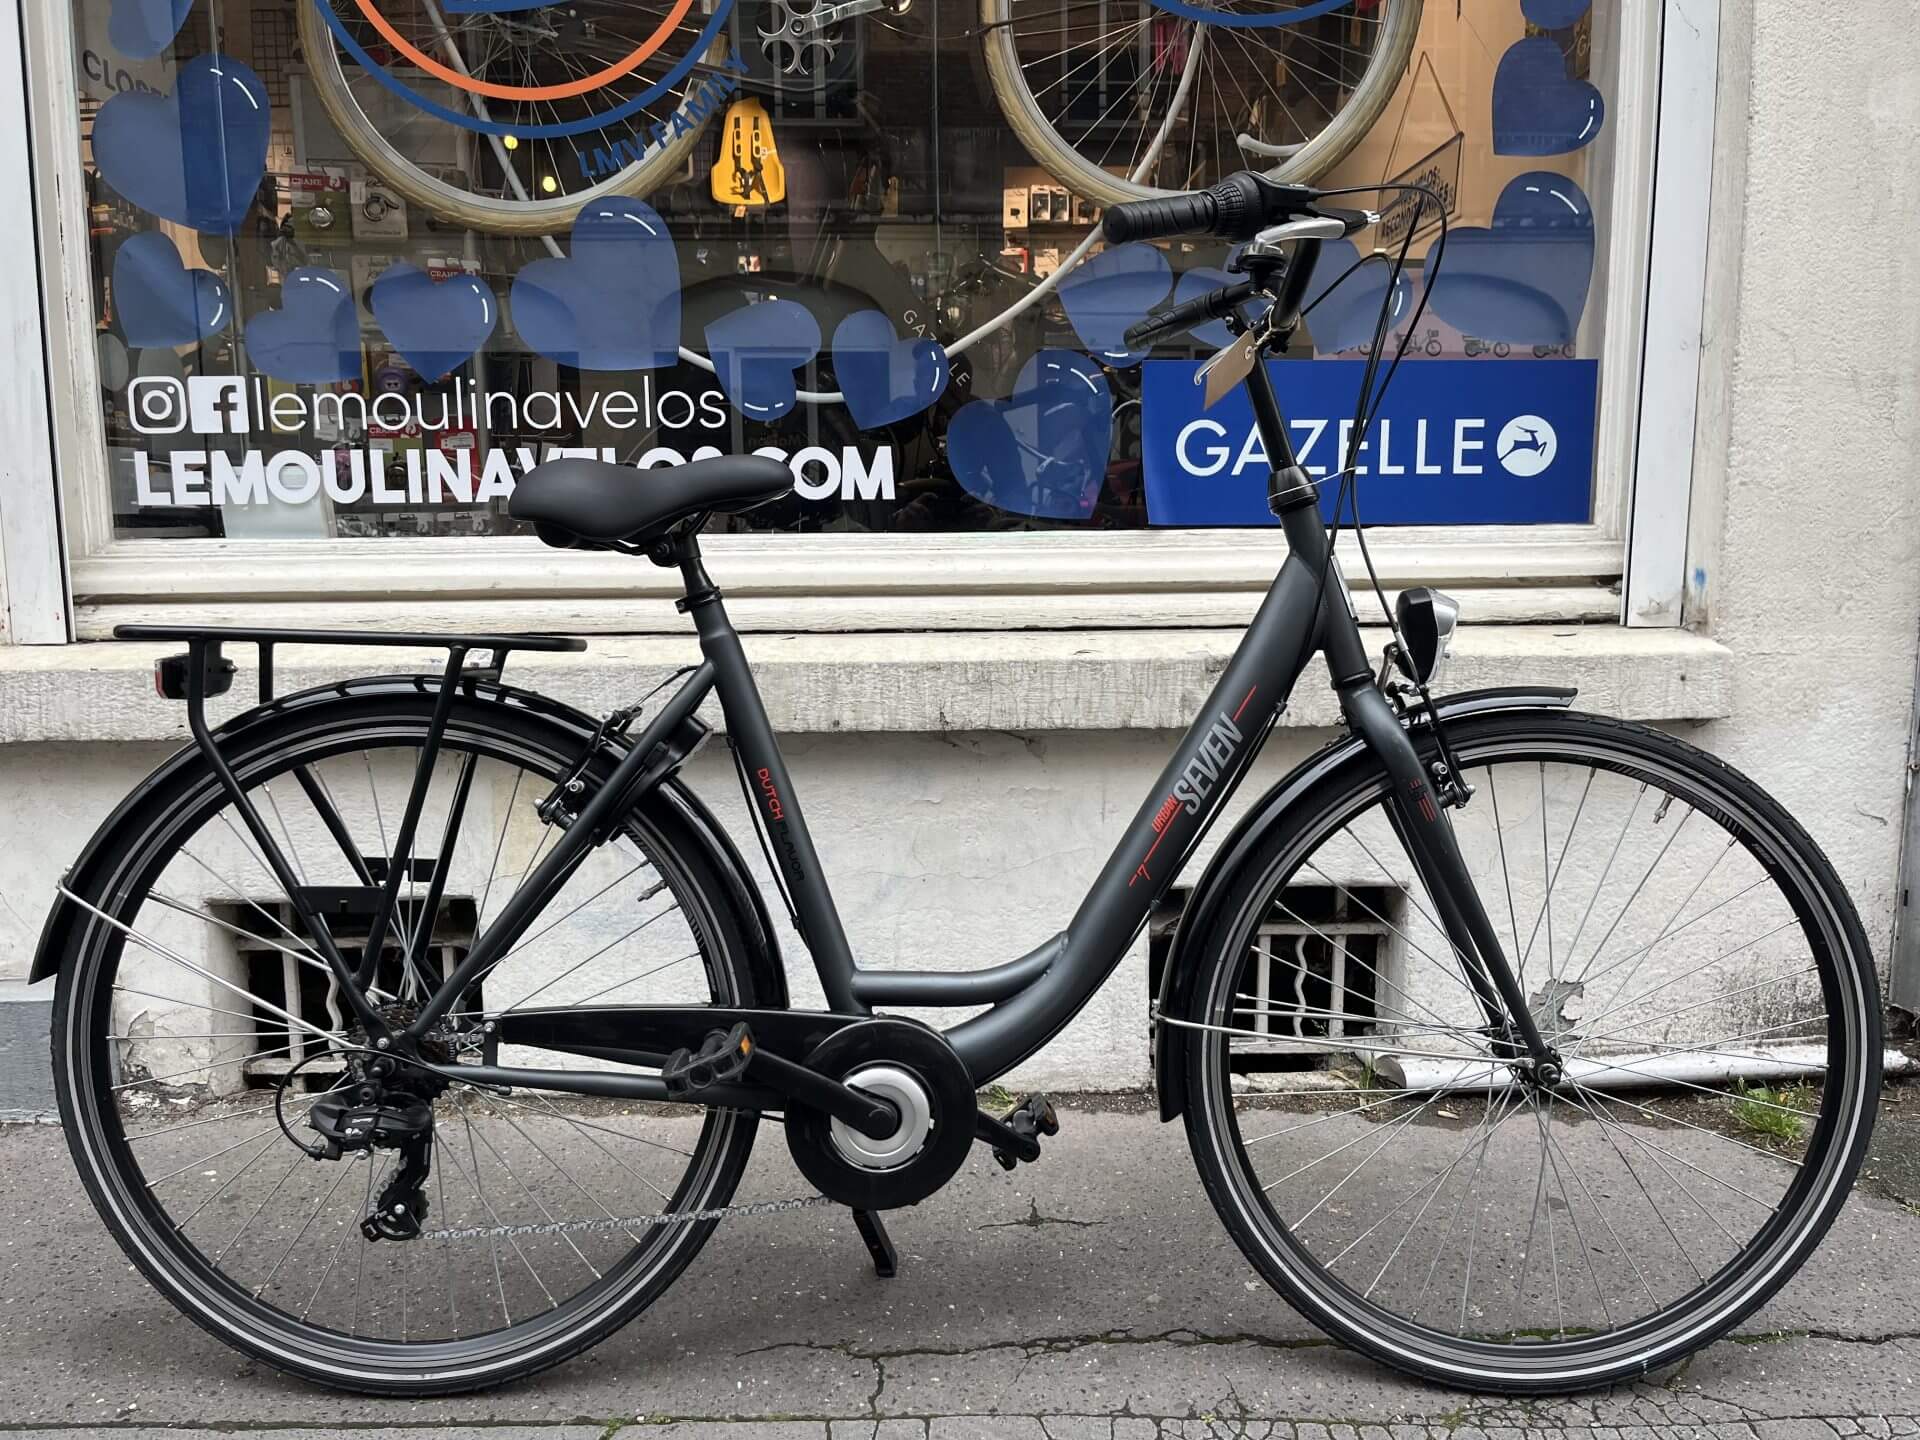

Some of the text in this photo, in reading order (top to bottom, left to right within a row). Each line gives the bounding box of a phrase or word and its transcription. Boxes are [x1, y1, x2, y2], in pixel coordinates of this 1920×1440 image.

[579, 47, 749, 177] LMV FAMILY
[903, 309, 970, 386] GALE
[254, 376, 727, 431] lemoulinavelos
[134, 445, 896, 504] LEMOULINAOM
[1175, 418, 1486, 477] GAZELLE
[757, 767, 785, 821] DUTCH
[1151, 711, 1244, 833] URBAN SEVEN
